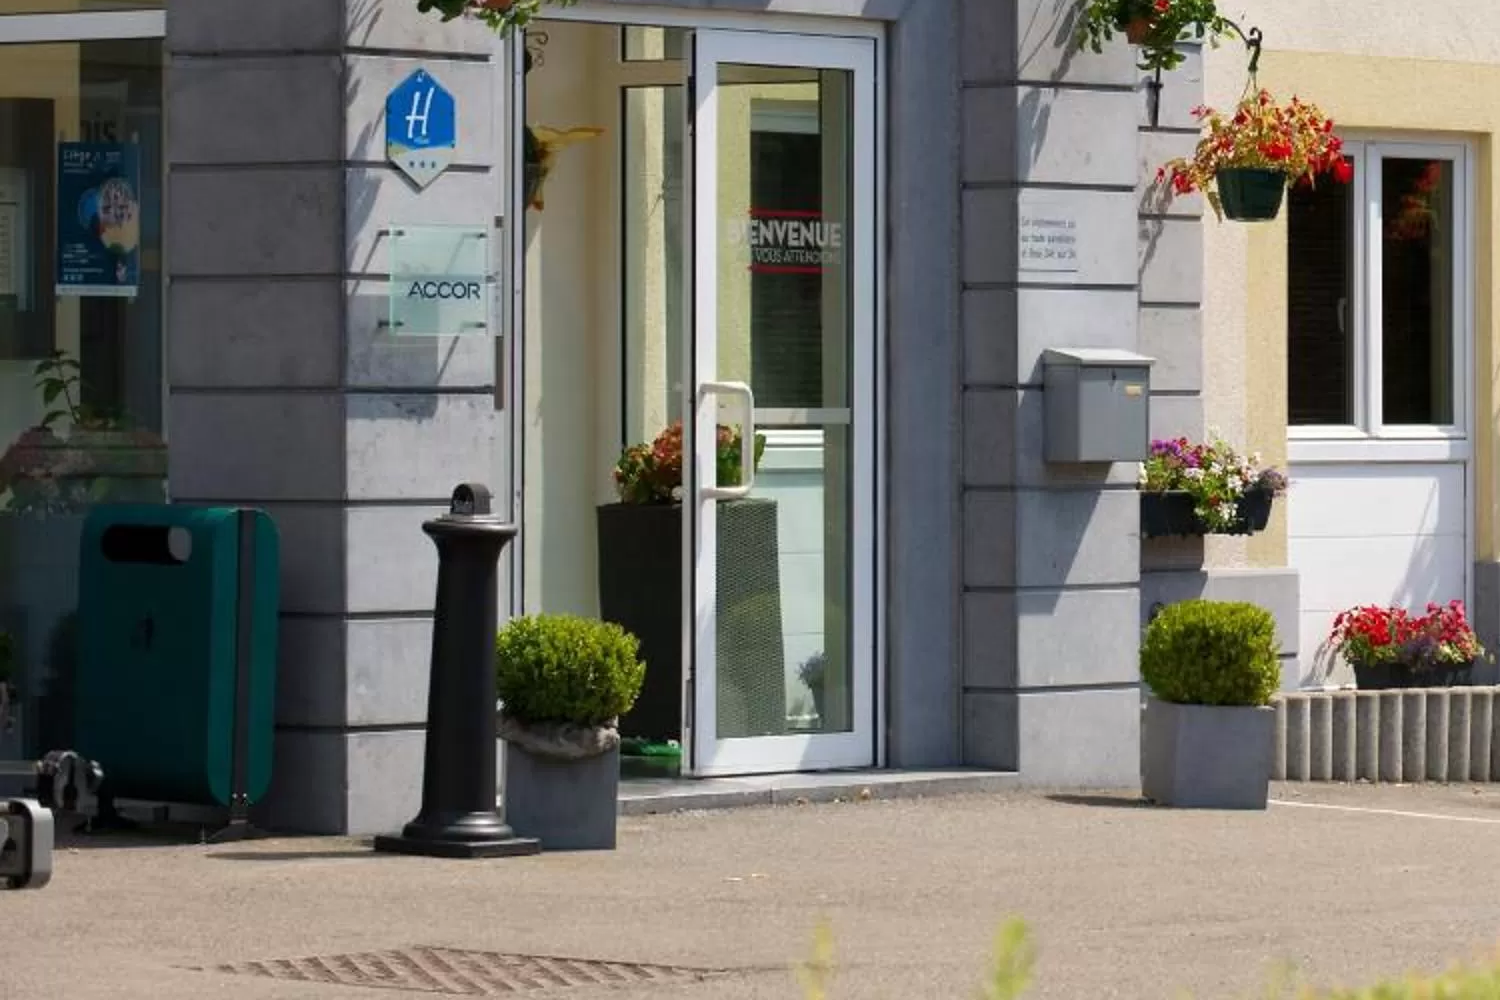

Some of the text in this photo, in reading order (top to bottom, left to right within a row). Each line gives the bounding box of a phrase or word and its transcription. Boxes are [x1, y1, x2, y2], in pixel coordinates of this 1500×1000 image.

[406, 87, 435, 138] H
[728, 219, 841, 247] BIENVENUE
[409, 282, 480, 299] ACCOR
